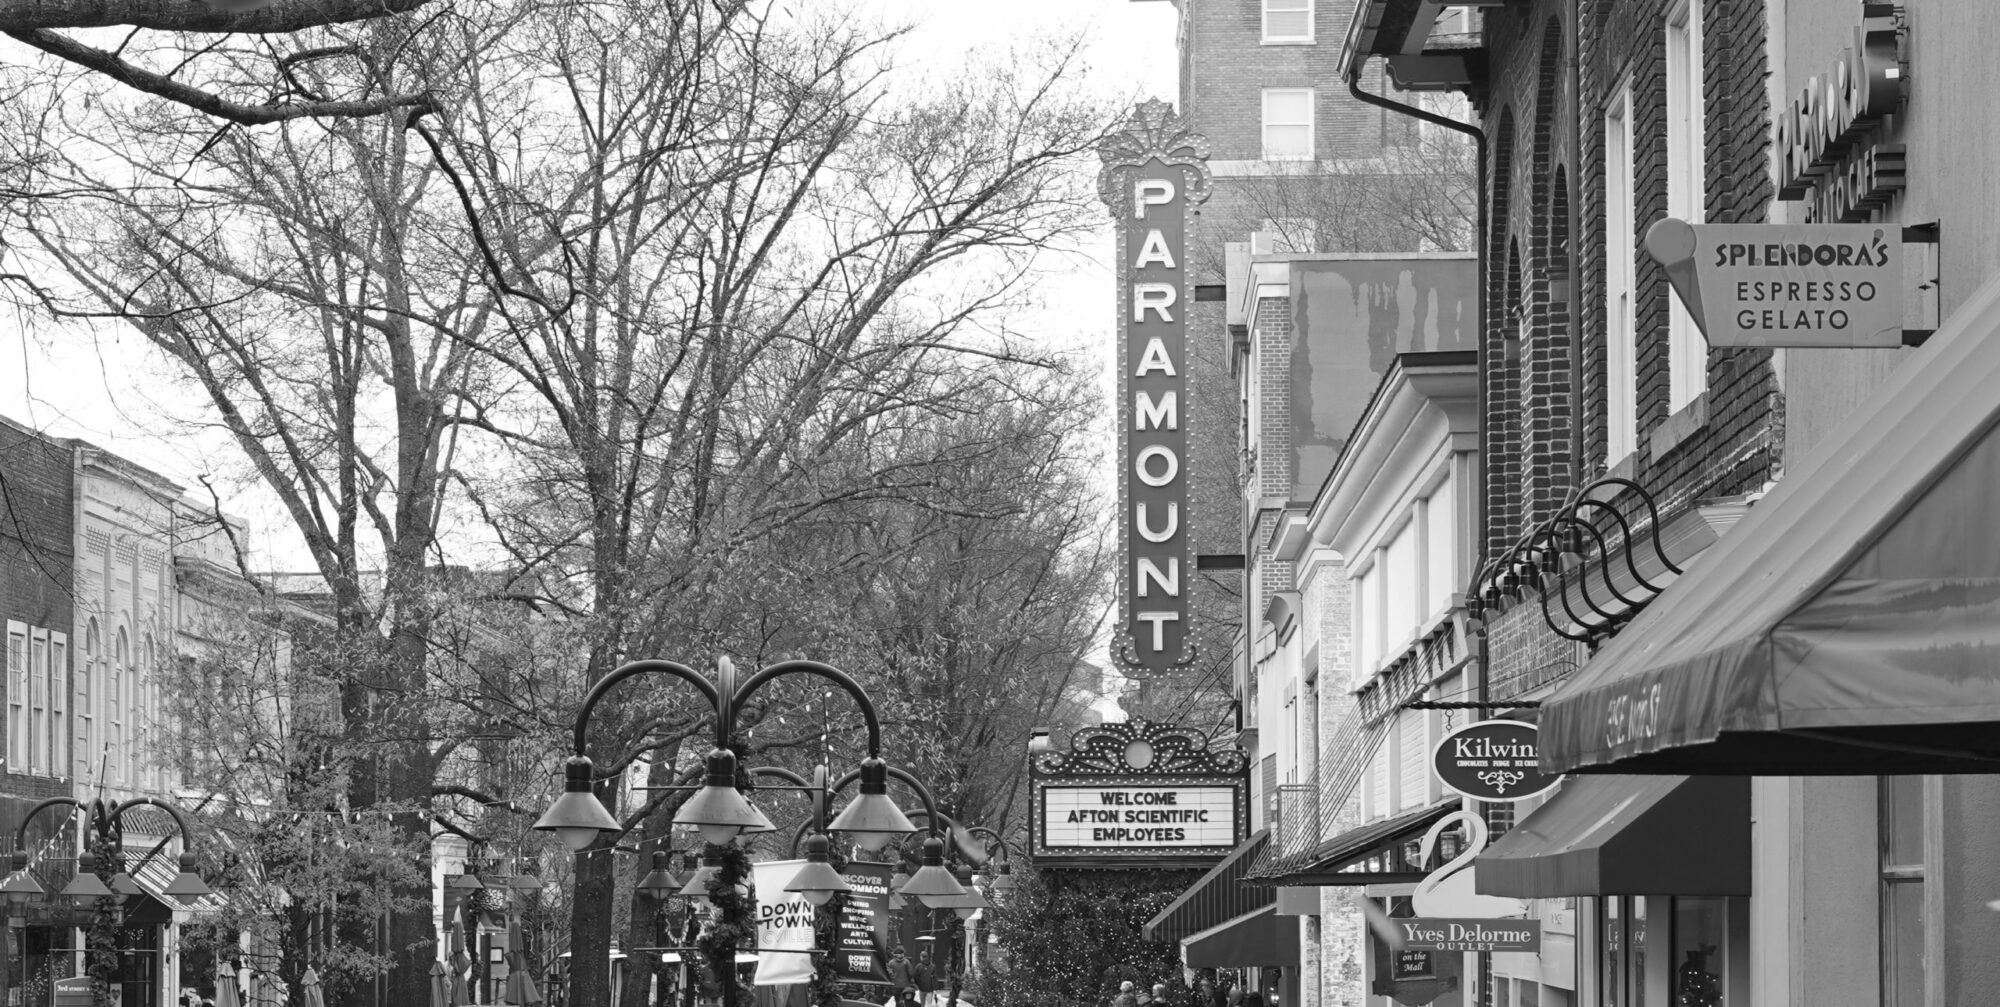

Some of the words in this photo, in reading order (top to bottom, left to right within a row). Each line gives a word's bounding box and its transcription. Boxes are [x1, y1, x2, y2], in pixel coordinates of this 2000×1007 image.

[1715, 231, 1888, 267] SPLENDORA'S
[1737, 281, 1876, 301] ESPRESSO
[1737, 309, 1849, 329] GELATO
[1134, 178, 1179, 652] PARAMOUNT
[1101, 792, 1177, 805] WELCOME
[1067, 810, 1119, 823] AFTON
[1125, 810, 1208, 823] SCIENTIFIC
[1093, 828, 1185, 841] EMPLOYEES
[762, 901, 812, 917] DOWN
[848, 900, 869, 908] DNING
[761, 915, 812, 930] TOWN
[1403, 923, 1444, 942] Yves
[1448, 923, 1531, 943] Delorme
[1436, 942, 1496, 951] OUTLET
[1414, 952, 1426, 960] the
[1403, 962, 1424, 972] Mall
